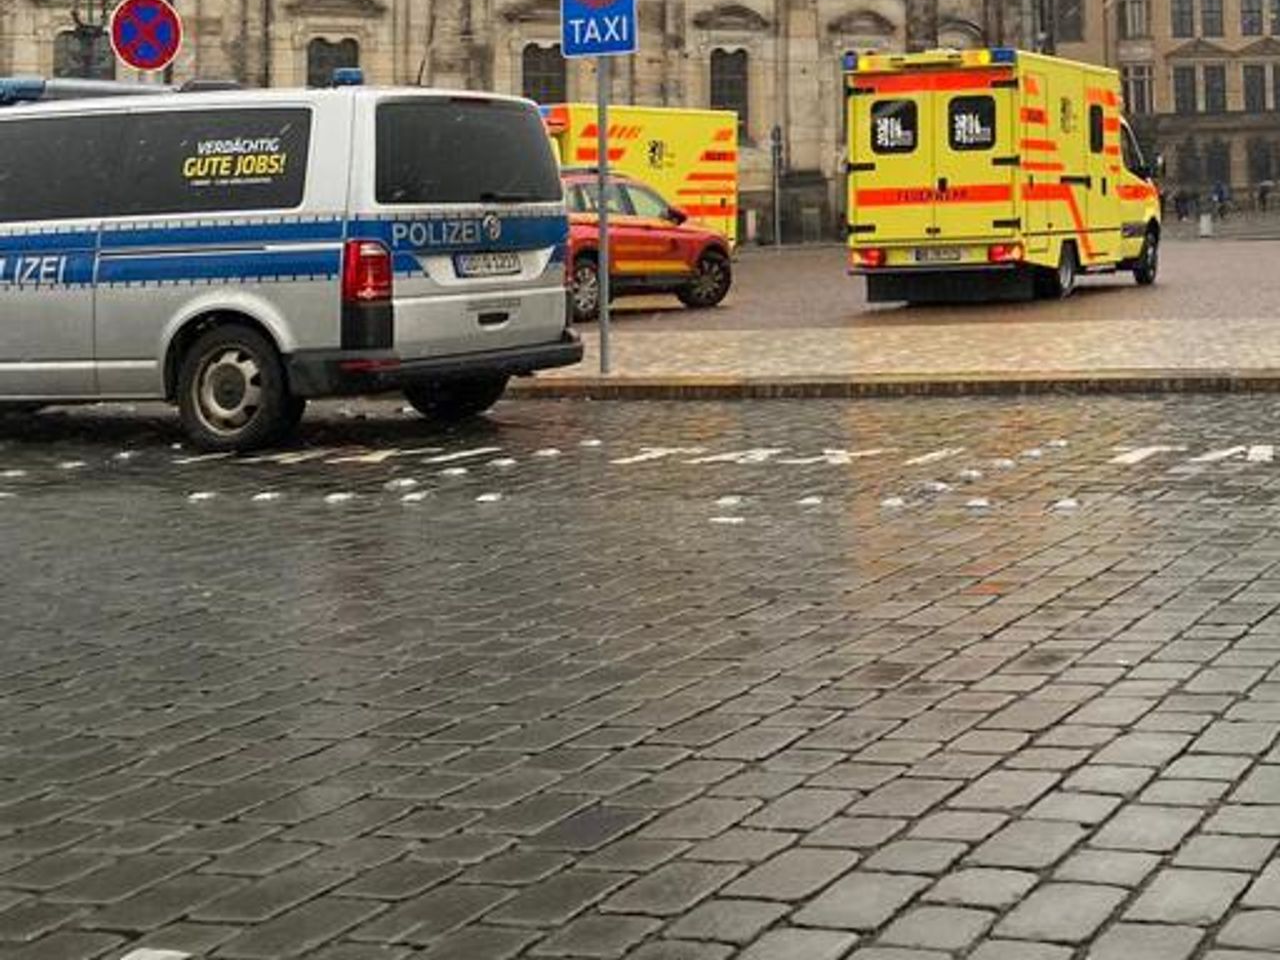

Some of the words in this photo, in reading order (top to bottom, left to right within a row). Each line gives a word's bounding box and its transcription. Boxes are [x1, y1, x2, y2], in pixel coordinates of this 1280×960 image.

[568, 14, 629, 45] TAXI
[183, 156, 232, 177] GUTE
[235, 153, 286, 176] JOBS!
[392, 220, 481, 247] POLIZEI
